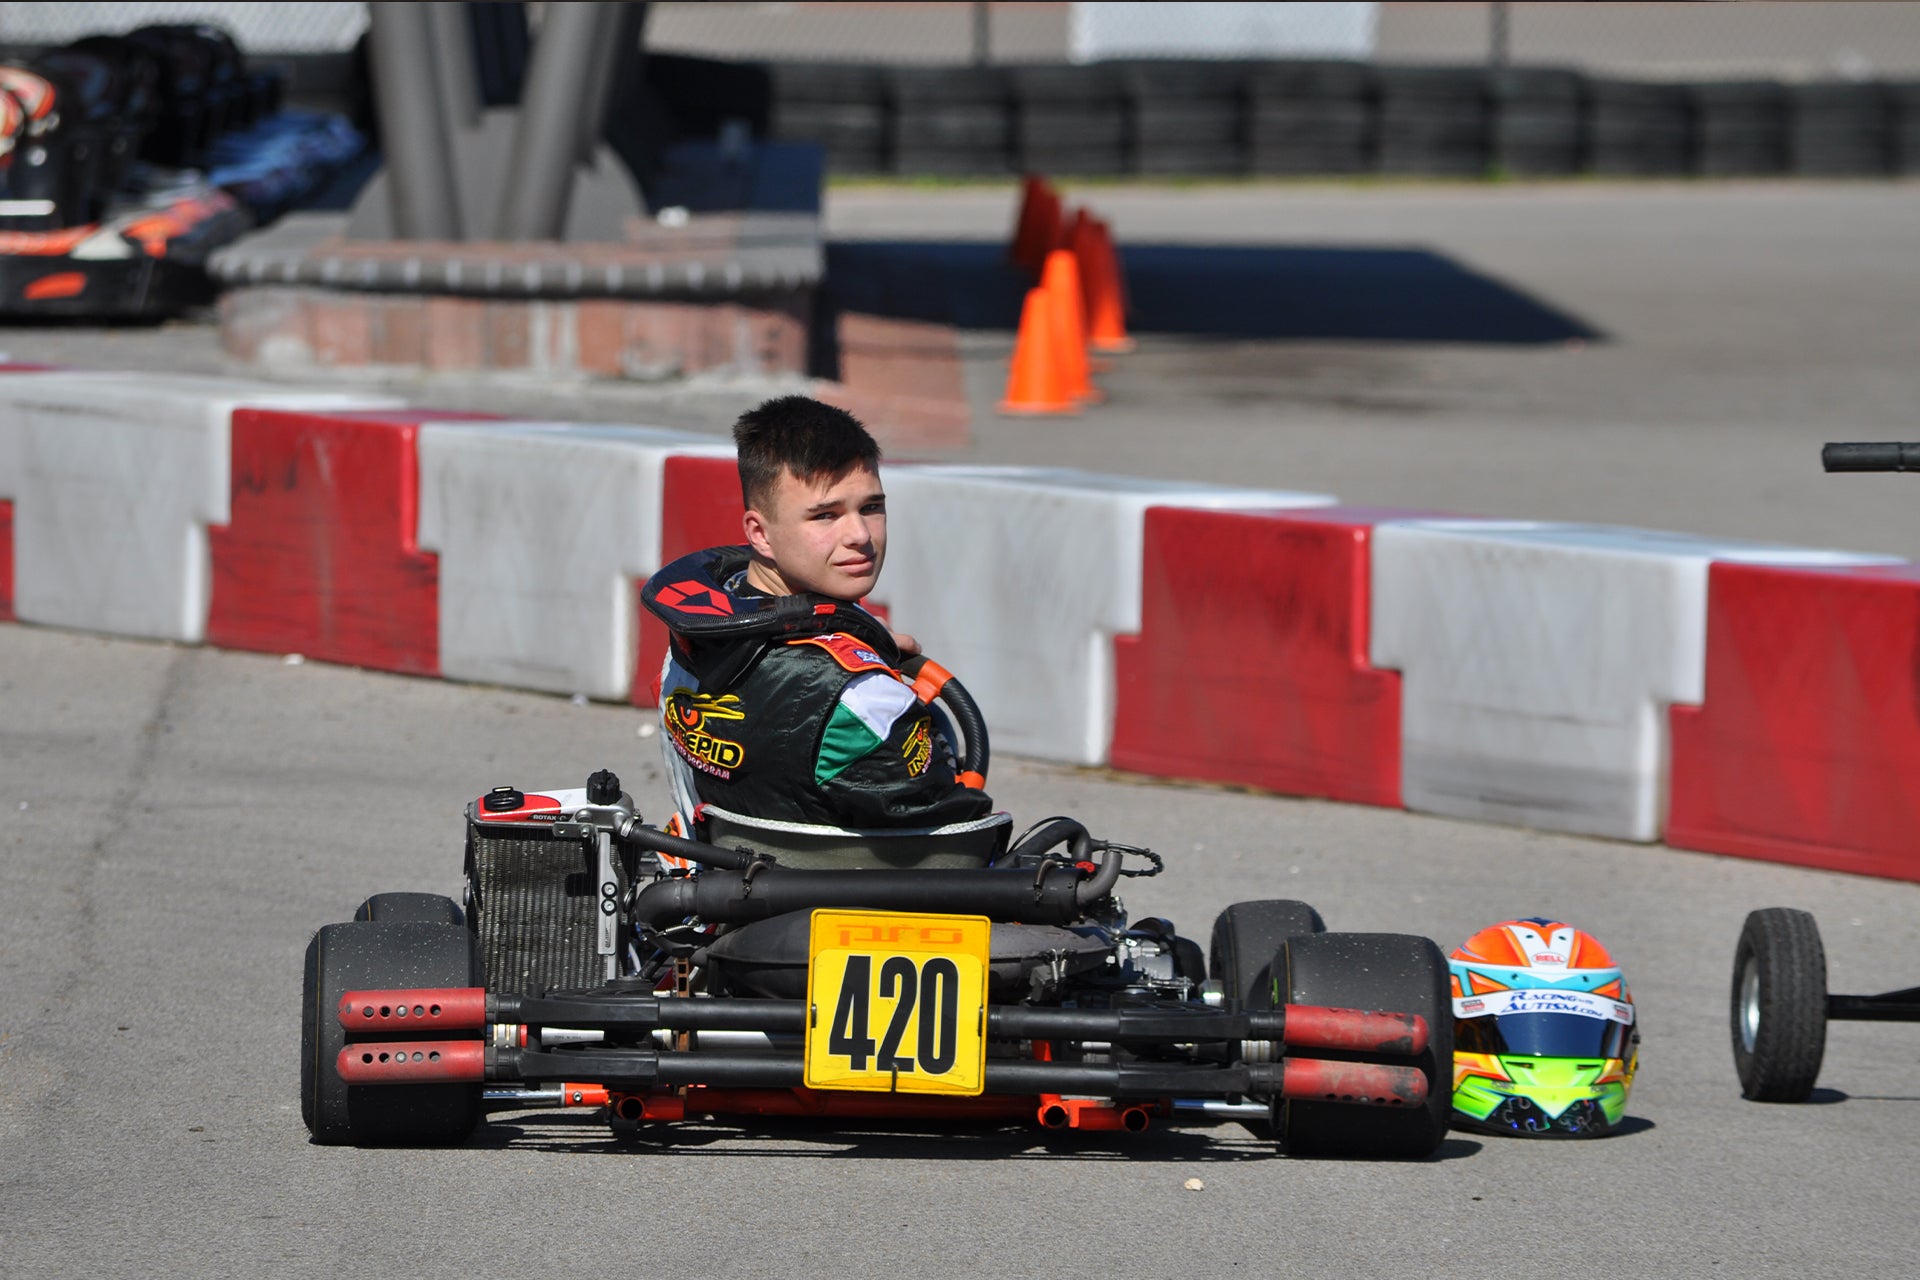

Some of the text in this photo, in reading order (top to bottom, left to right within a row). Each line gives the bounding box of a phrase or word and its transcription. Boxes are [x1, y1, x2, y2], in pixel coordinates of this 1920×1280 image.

[687, 754, 731, 780] PROGRAM
[1535, 954, 1564, 963] BELL
[829, 955, 958, 1075] 420
